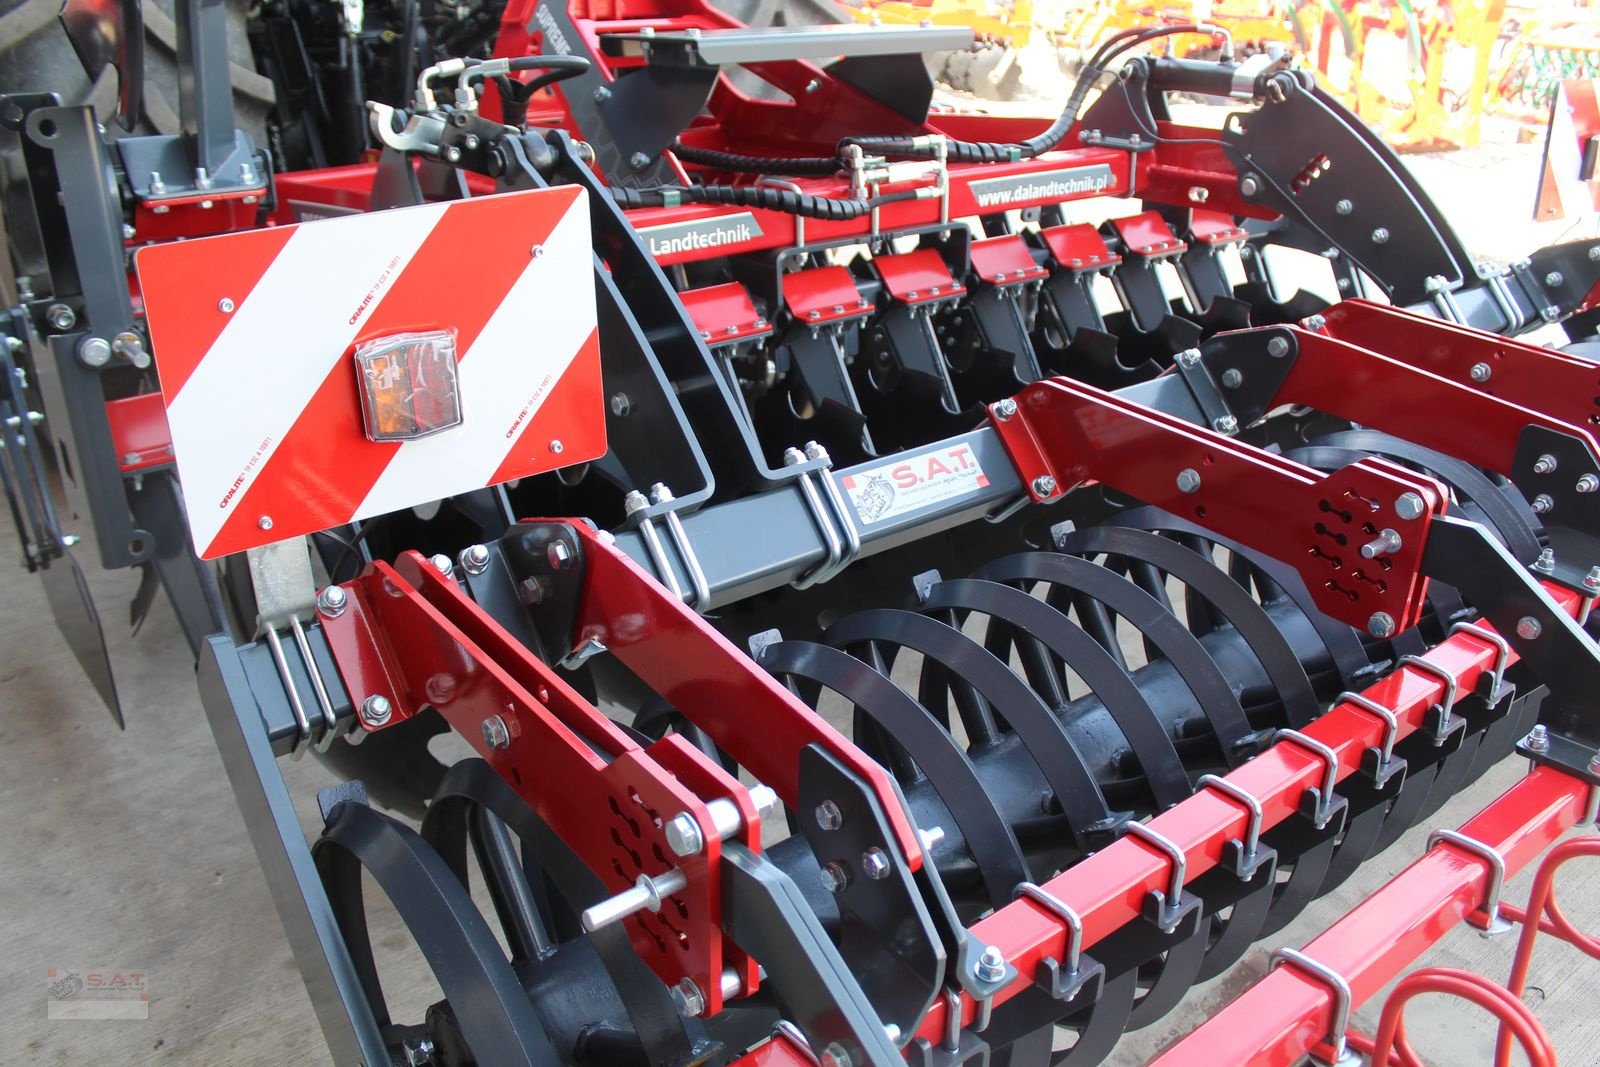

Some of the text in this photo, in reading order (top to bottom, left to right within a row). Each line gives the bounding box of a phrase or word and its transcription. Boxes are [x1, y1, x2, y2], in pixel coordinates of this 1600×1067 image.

[536, 3, 571, 56] SUPREME
[978, 174, 1107, 207] www.dalandtechnik.pl
[650, 223, 751, 256] Landtechnik
[891, 447, 976, 489] S.A.T.
